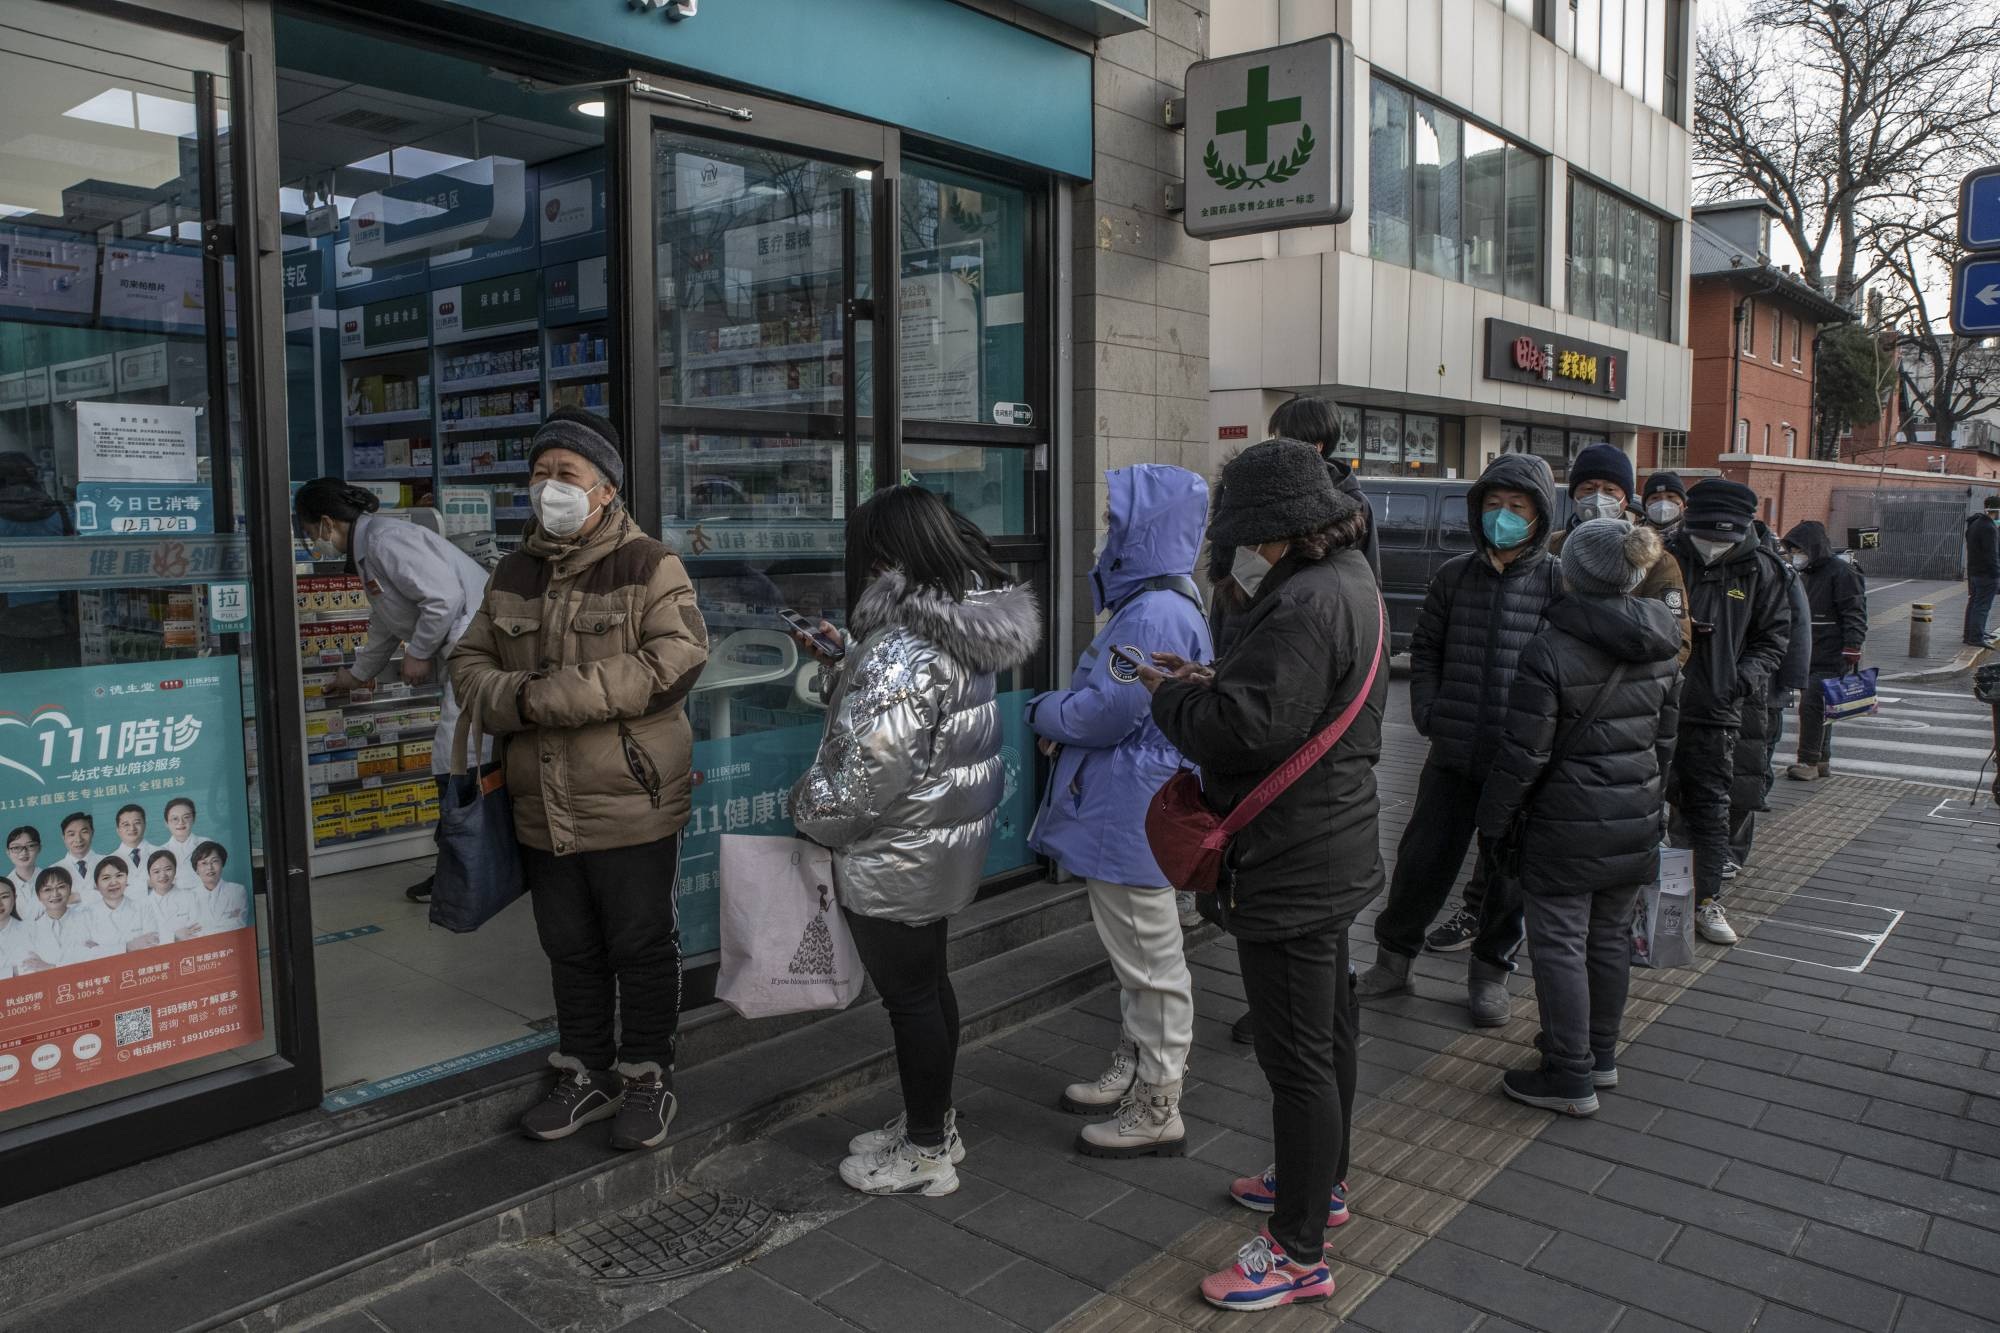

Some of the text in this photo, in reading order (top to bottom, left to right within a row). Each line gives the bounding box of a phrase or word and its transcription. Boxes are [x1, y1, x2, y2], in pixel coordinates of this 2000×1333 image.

[1201, 194, 1315, 217] 全国药品零售企业统一标志
[758, 231, 812, 256] 医疗器械
[282, 264, 308, 288] 专区
[106, 496, 202, 512] 今日已消毒
[89, 542, 245, 578] 健康好邻居
[217, 588, 241, 609] 拉
[39, 714, 203, 767] 111陪诊
[56, 757, 182, 782] 一站式专业陪诊服务
[707, 761, 751, 779] 111医药馆
[683, 787, 791, 838] 11健康管
[196, 948, 235, 963] 年服务客户
[137, 962, 170, 976] 健康管家
[76, 975, 111, 990] 专科专家
[138, 972, 169, 986] 1000+名
[777, 979, 789, 987] you
[6, 991, 44, 1007] 执业药师
[76, 988, 104, 1001] 100+名
[7, 1003, 42, 1017] 1000+名
[156, 991, 239, 1018] 扫码预约 了解更多
[181, 1022, 241, 1045] 18910596311
